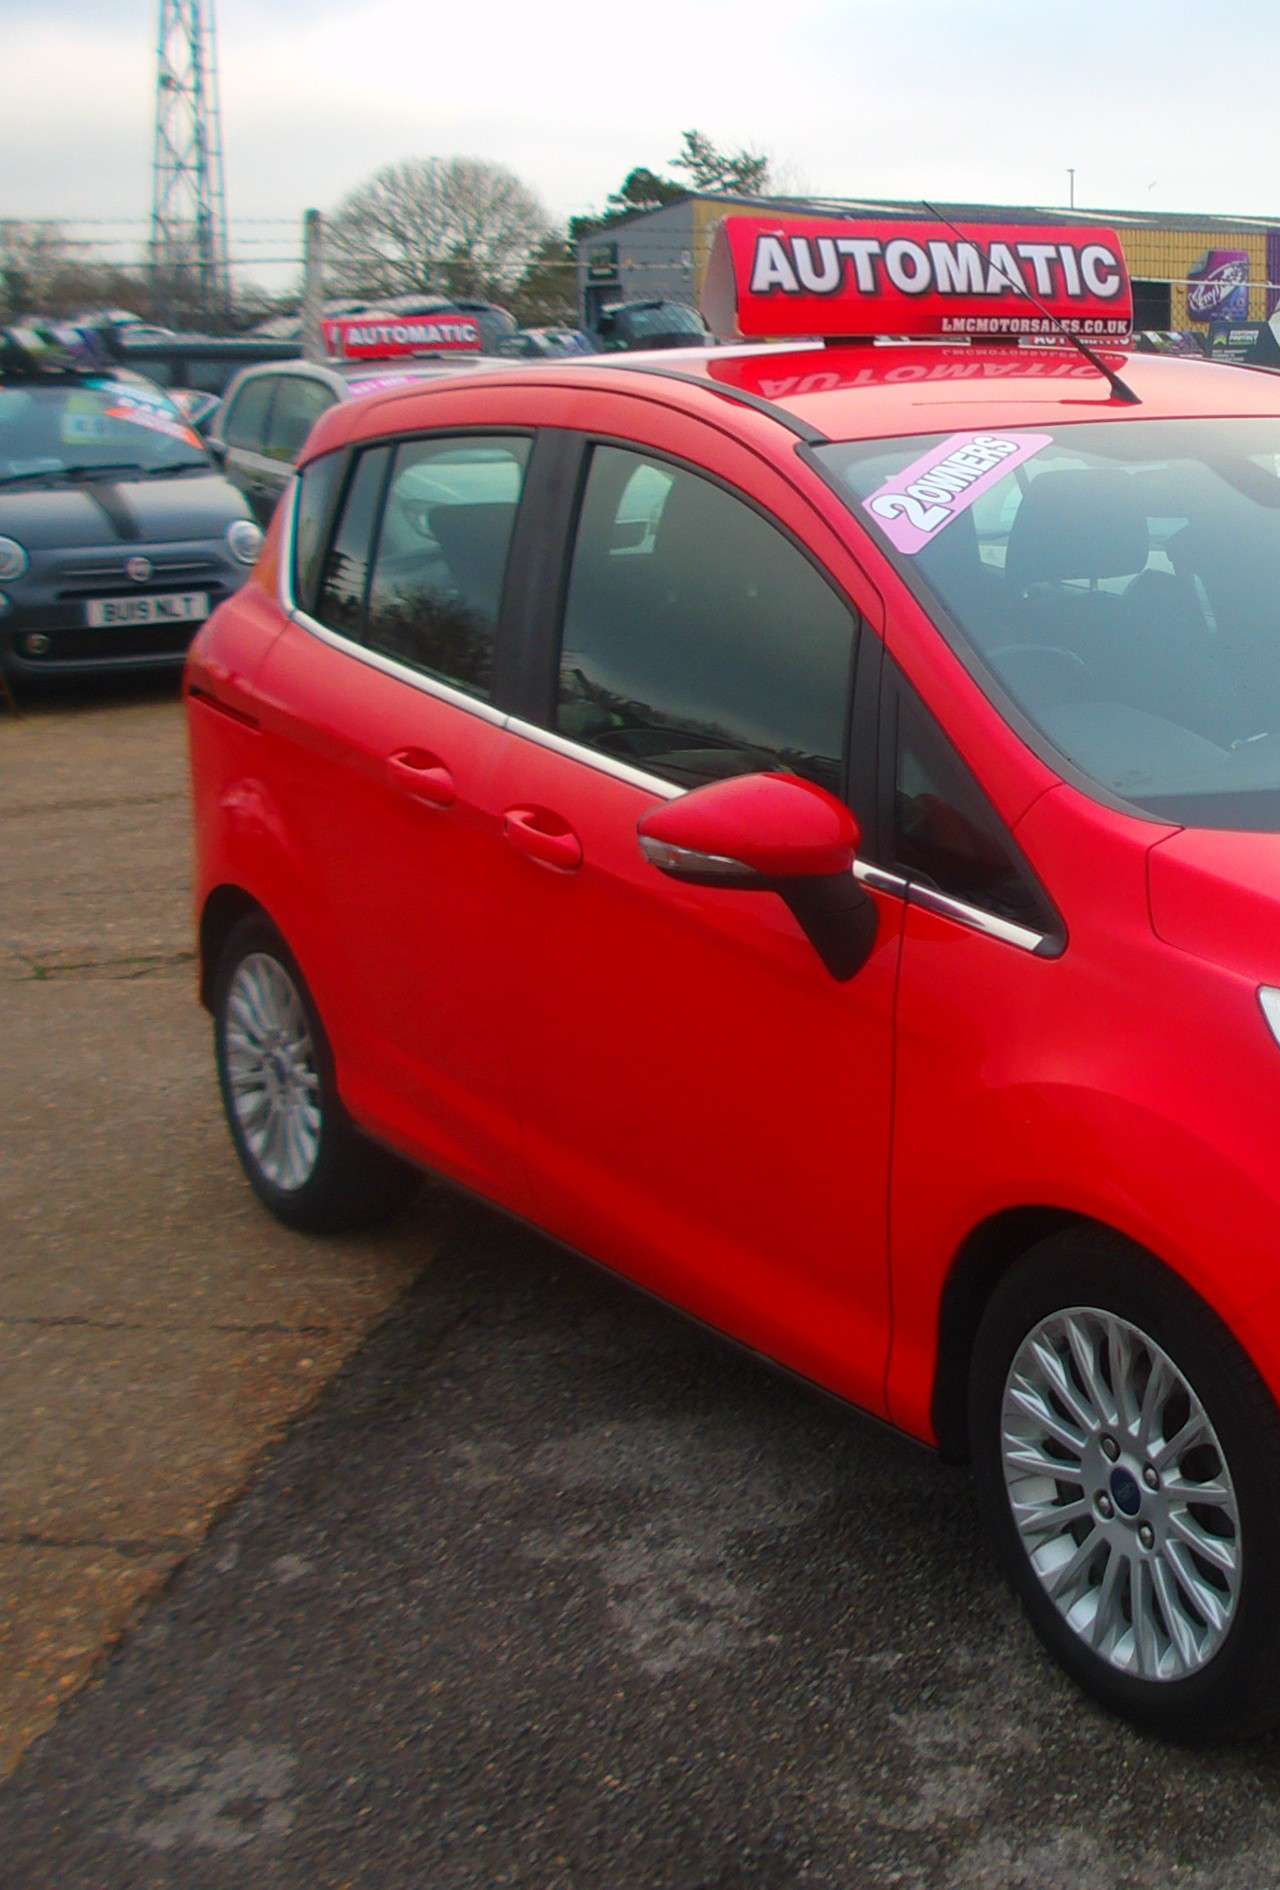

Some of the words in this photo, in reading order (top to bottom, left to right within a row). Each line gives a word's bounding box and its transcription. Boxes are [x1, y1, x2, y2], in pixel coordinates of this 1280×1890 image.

[750, 235, 1122, 298] AUTOMATIC
[347, 324, 477, 345] AUTOMATIC
[941, 317, 1128, 334] LMCMOTORSALES.CO.UK
